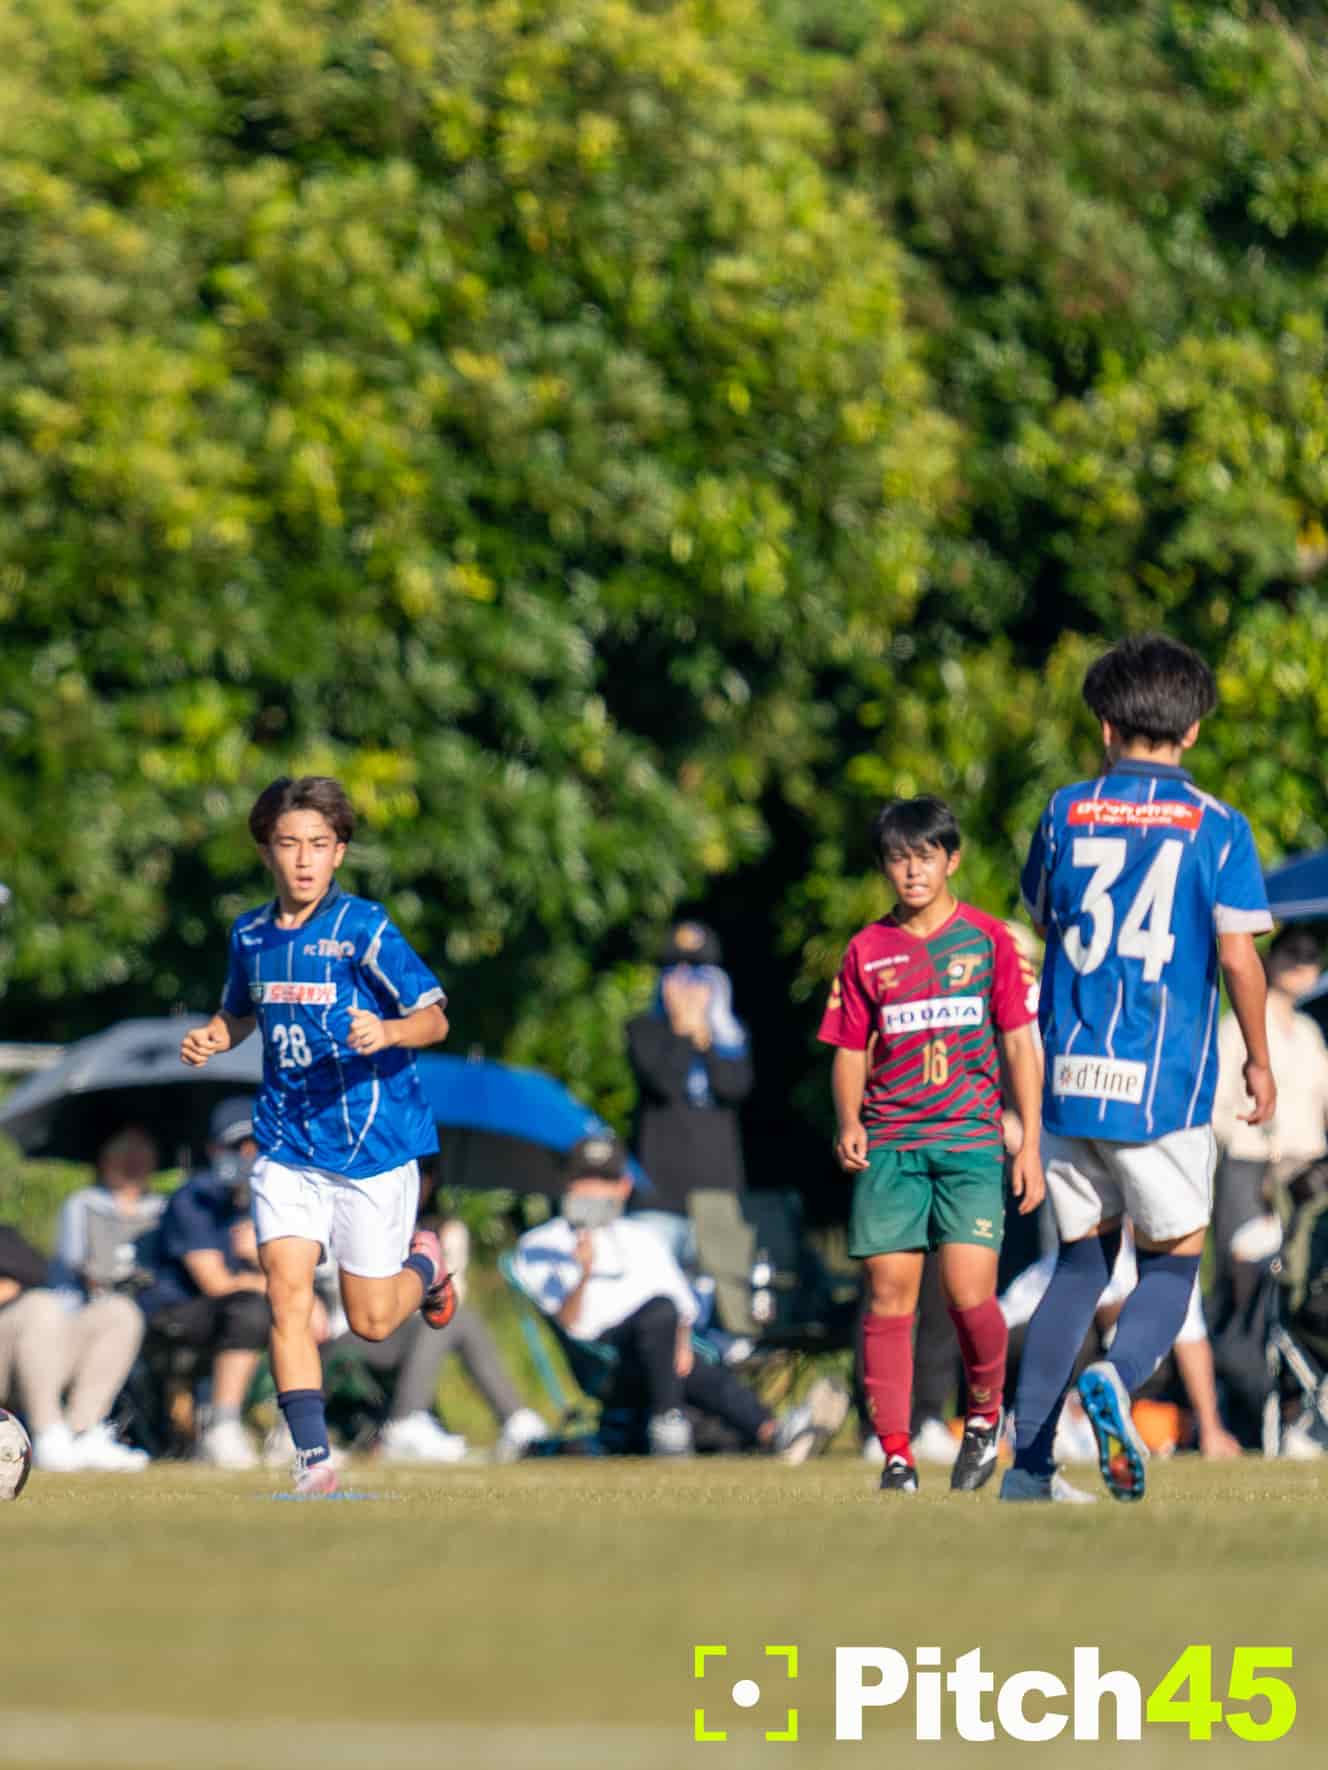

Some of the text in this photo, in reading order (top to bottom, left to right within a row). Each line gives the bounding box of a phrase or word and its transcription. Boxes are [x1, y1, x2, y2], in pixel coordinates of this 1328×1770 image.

[1063, 837, 1184, 982] 34
[920, 1006, 978, 1021] DATA
[272, 1023, 312, 1069] 28
[922, 1038, 949, 1086] 16
[1076, 1063, 1138, 1094] d'fine
